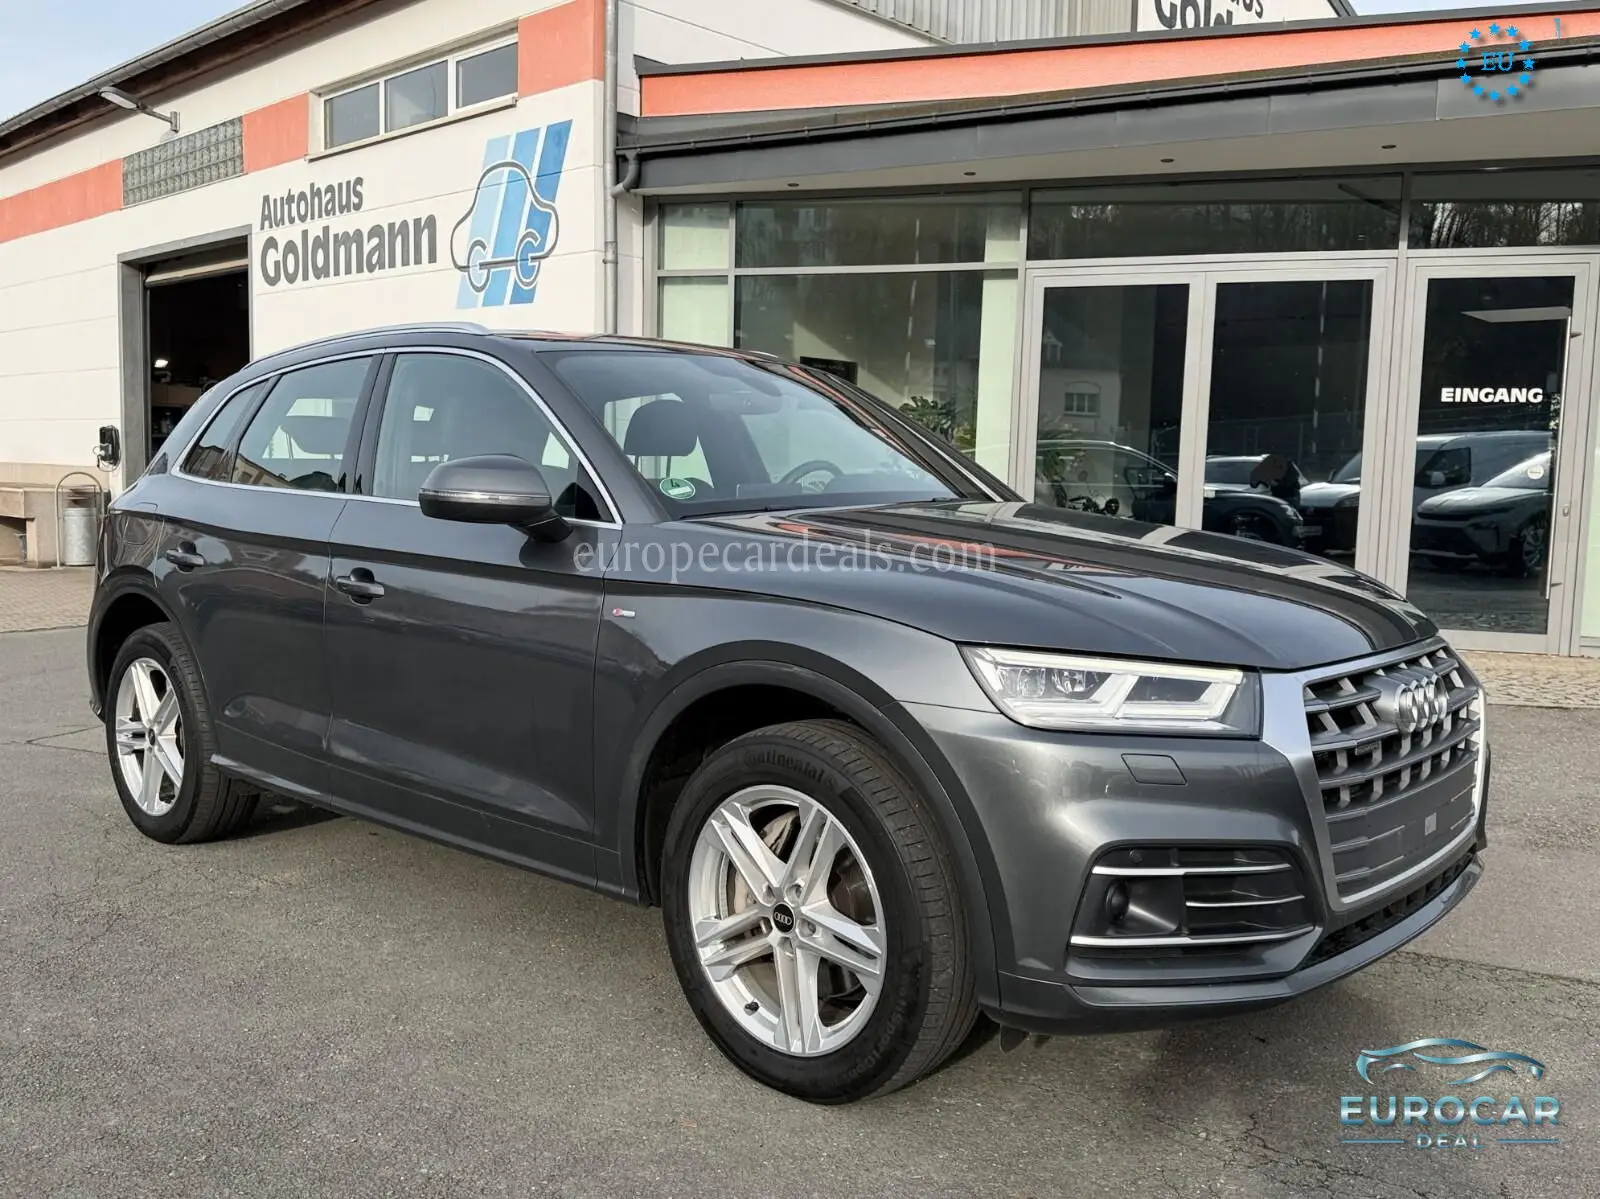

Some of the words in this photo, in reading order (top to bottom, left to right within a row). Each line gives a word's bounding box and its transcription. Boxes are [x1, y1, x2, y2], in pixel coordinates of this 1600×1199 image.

[260, 176, 364, 231] Autohaus
[260, 214, 437, 287] Goldmann
[1440, 387, 1543, 403] EINGANG
